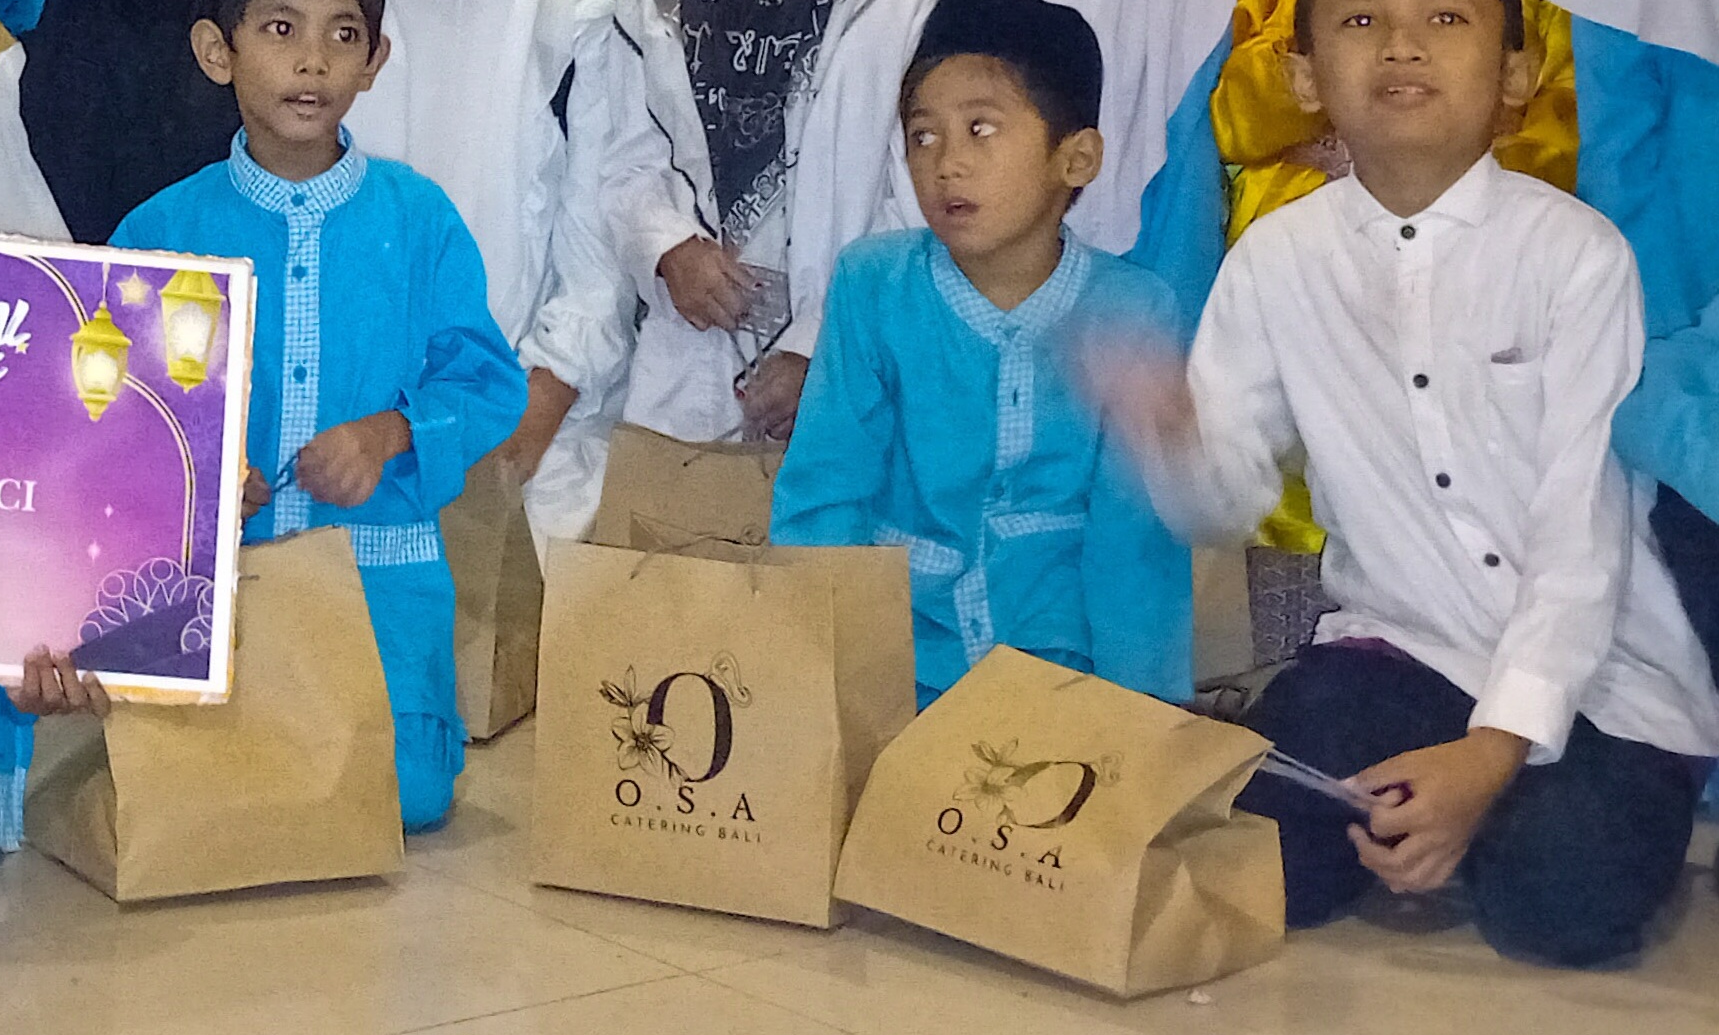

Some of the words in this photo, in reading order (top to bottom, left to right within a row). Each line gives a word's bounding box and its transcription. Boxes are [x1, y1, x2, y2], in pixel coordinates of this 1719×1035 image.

[610, 813, 706, 837] CATERING
[717, 827, 762, 844] BALI
[926, 839, 1013, 877] CATERING
[1024, 869, 1065, 892] BALI
